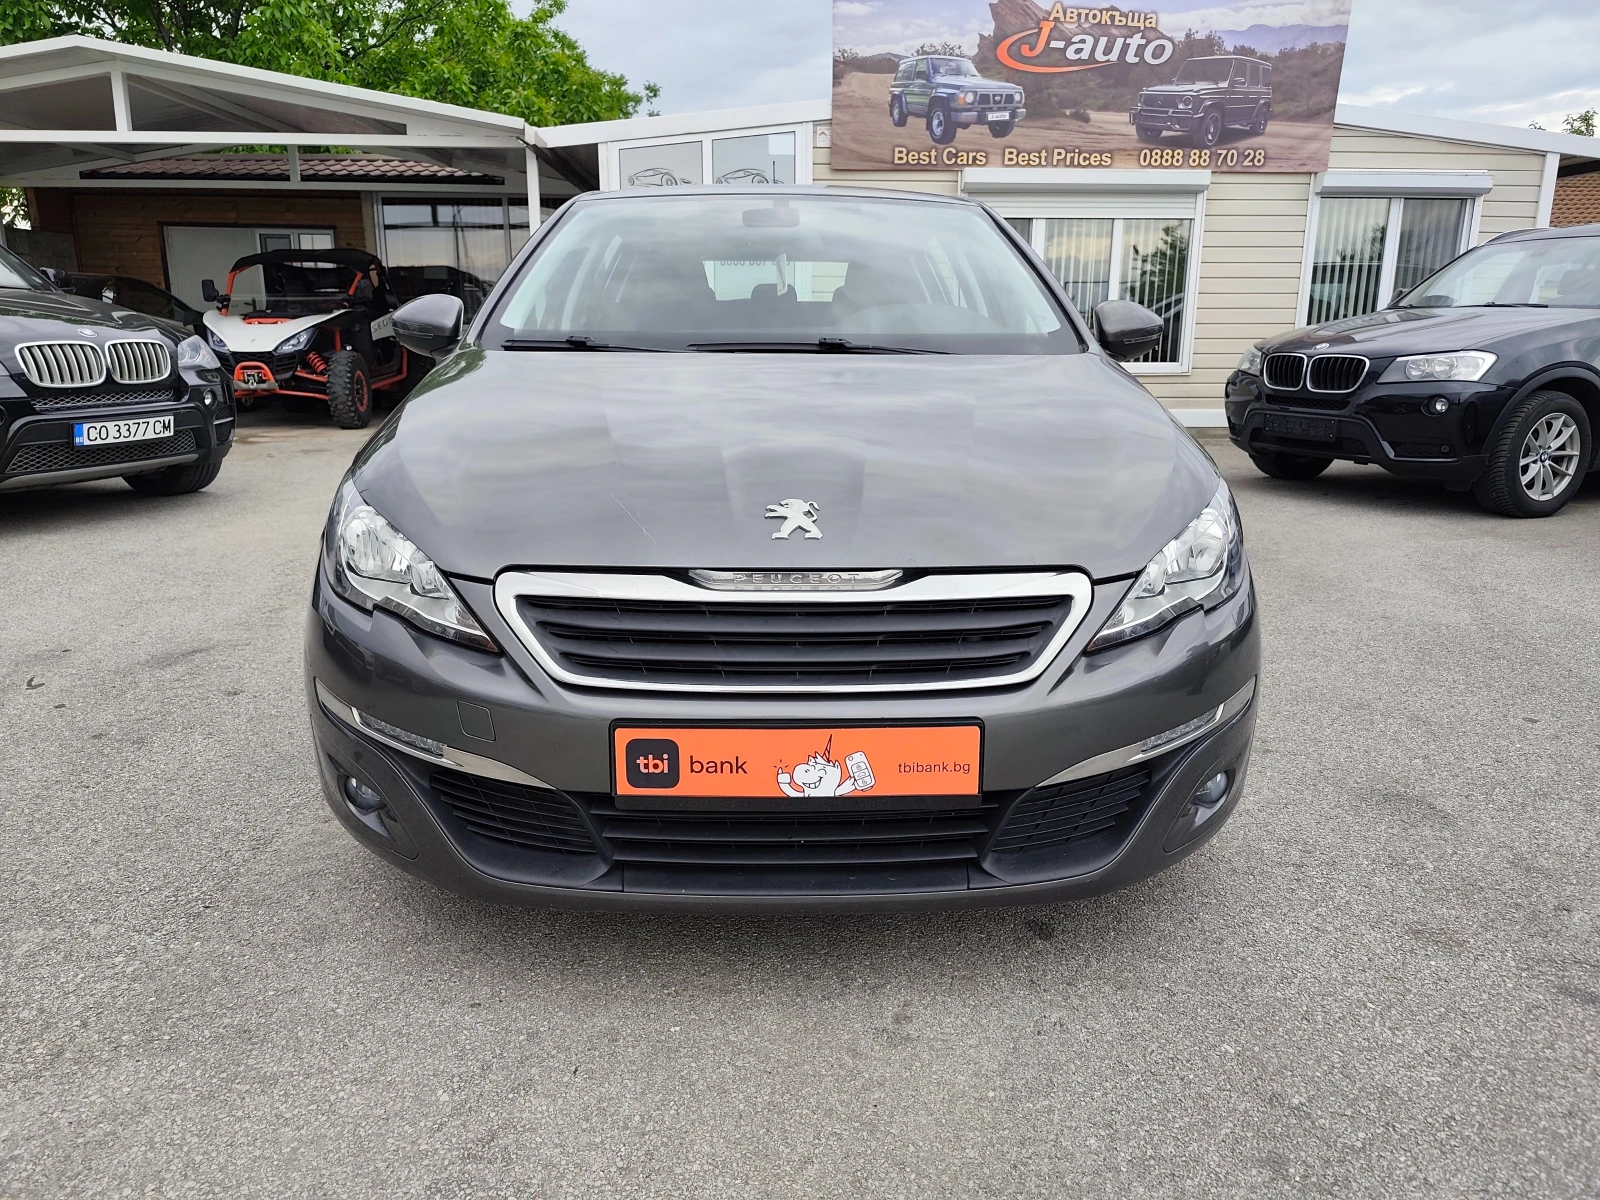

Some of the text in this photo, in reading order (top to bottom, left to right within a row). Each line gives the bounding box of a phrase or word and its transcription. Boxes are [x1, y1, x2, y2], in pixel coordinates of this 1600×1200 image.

[1049, 2, 1157, 30] Автокъща
[1020, 20, 1174, 65] J-auto
[893, 147, 1265, 167] Best Cars Best Prices 0888 88 70 28
[113, 421, 150, 439] 3377
[733, 573, 860, 584] PEUGEOT
[636, 753, 748, 775] tbi bank
[897, 761, 971, 775] tbibank.bg
